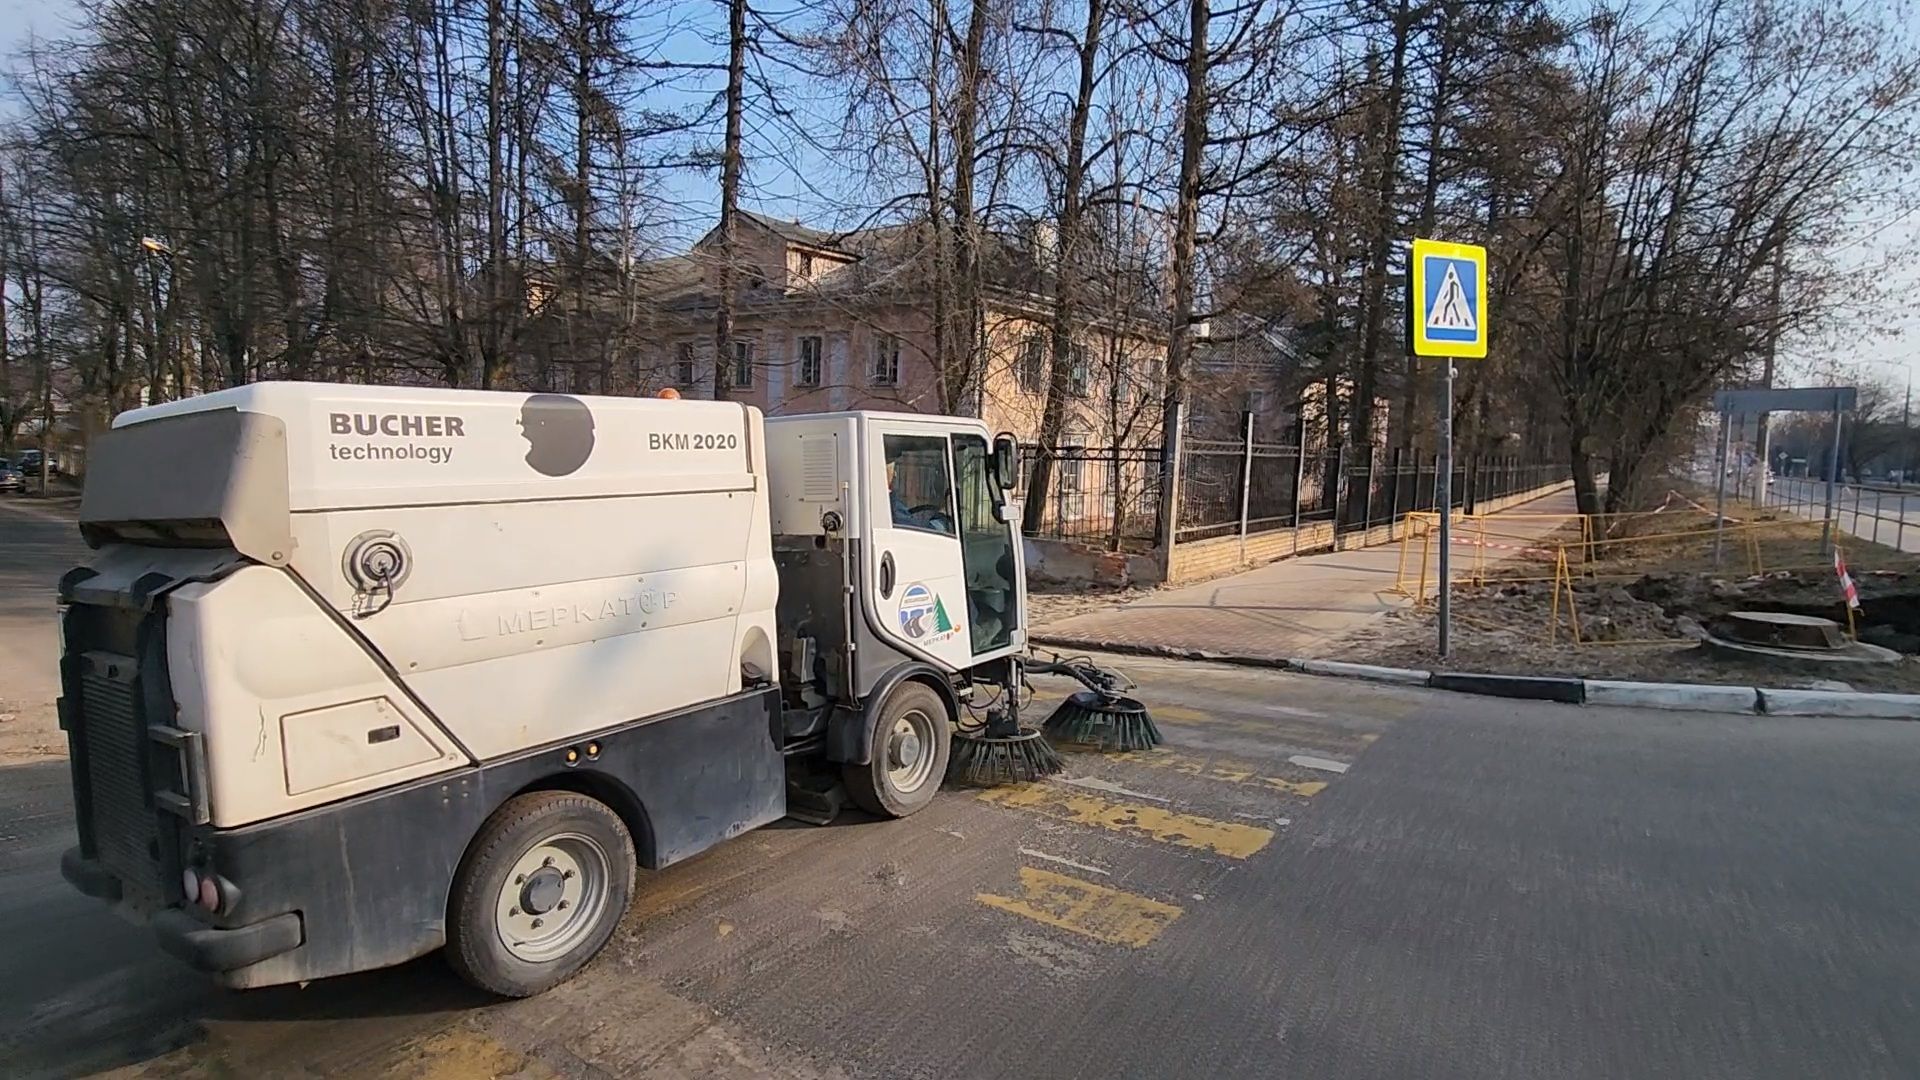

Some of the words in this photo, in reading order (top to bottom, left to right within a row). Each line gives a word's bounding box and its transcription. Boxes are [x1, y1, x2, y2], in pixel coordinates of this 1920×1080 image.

[330, 413, 465, 437] BUCHER
[649, 433, 689, 450] BKM
[693, 434, 737, 449] 2020
[330, 443, 453, 464] technology
